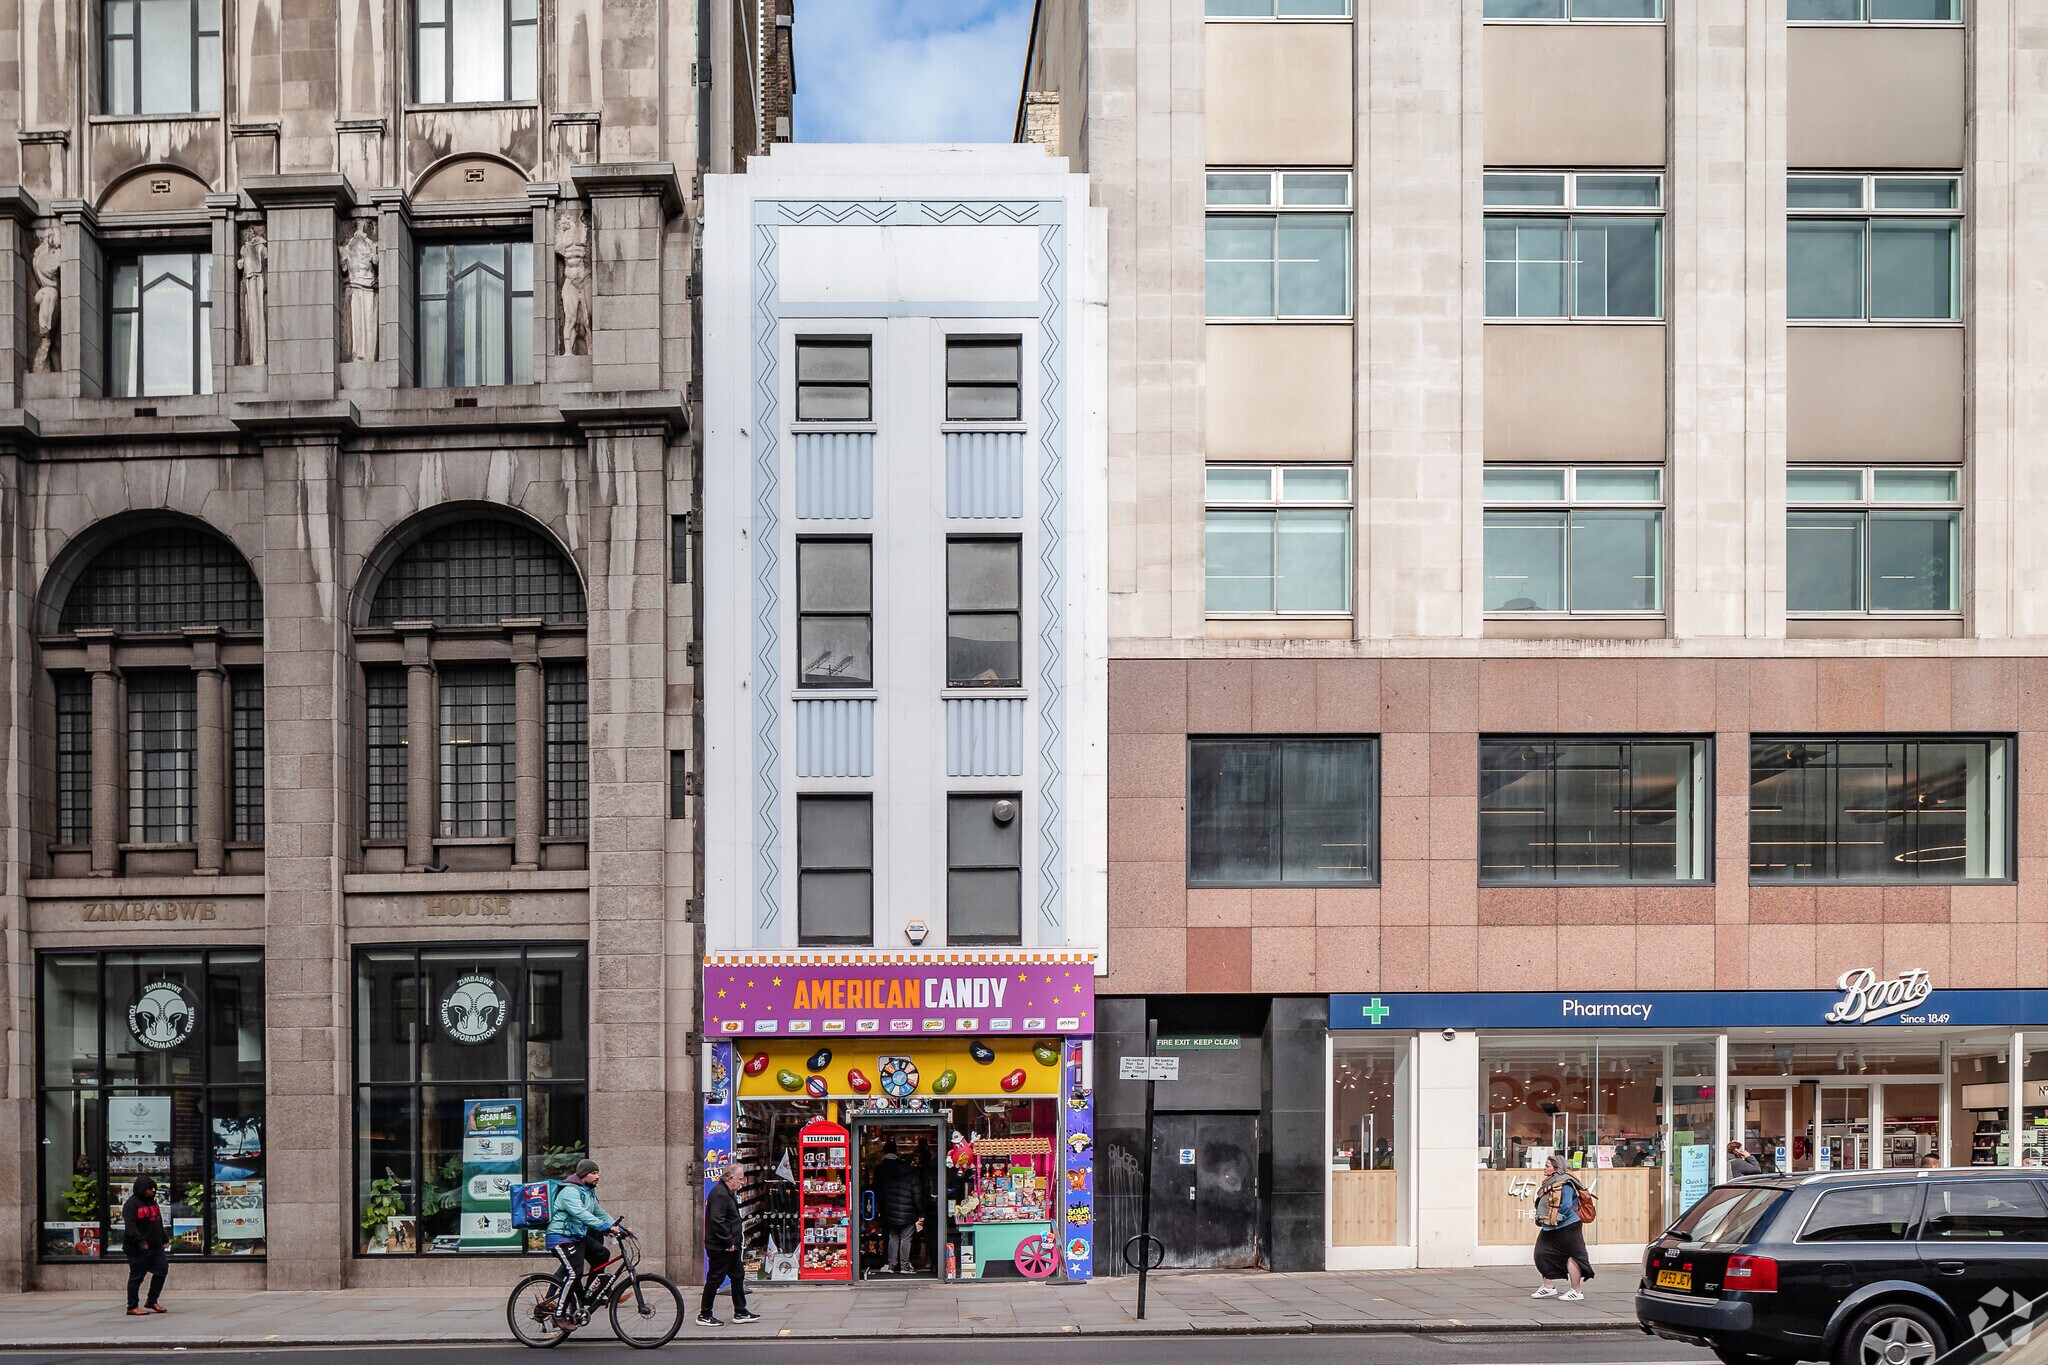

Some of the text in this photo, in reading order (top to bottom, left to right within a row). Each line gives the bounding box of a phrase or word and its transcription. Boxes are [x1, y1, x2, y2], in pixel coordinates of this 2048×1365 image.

[83, 896, 512, 922] ZIMBABWE HOUSE
[144, 982, 182, 994] ZIMBABWE
[457, 976, 494, 987] ZIMBABWE
[793, 978, 1008, 1010] AMERICAN CANDY
[1824, 967, 1932, 1024] Boots
[1562, 1000, 1652, 1020] Pharmacy
[442, 999, 506, 1042] TOURIST INFORMATION CENTRE
[1900, 1014, 1949, 1023] Since 1849
[129, 1005, 194, 1049] TOURIST INFORMATION CENTRE
[480, 1114, 498, 1122] SCAN
[1067, 1214, 1090, 1222] PATCH
[1068, 1207, 1089, 1215] SOUR
